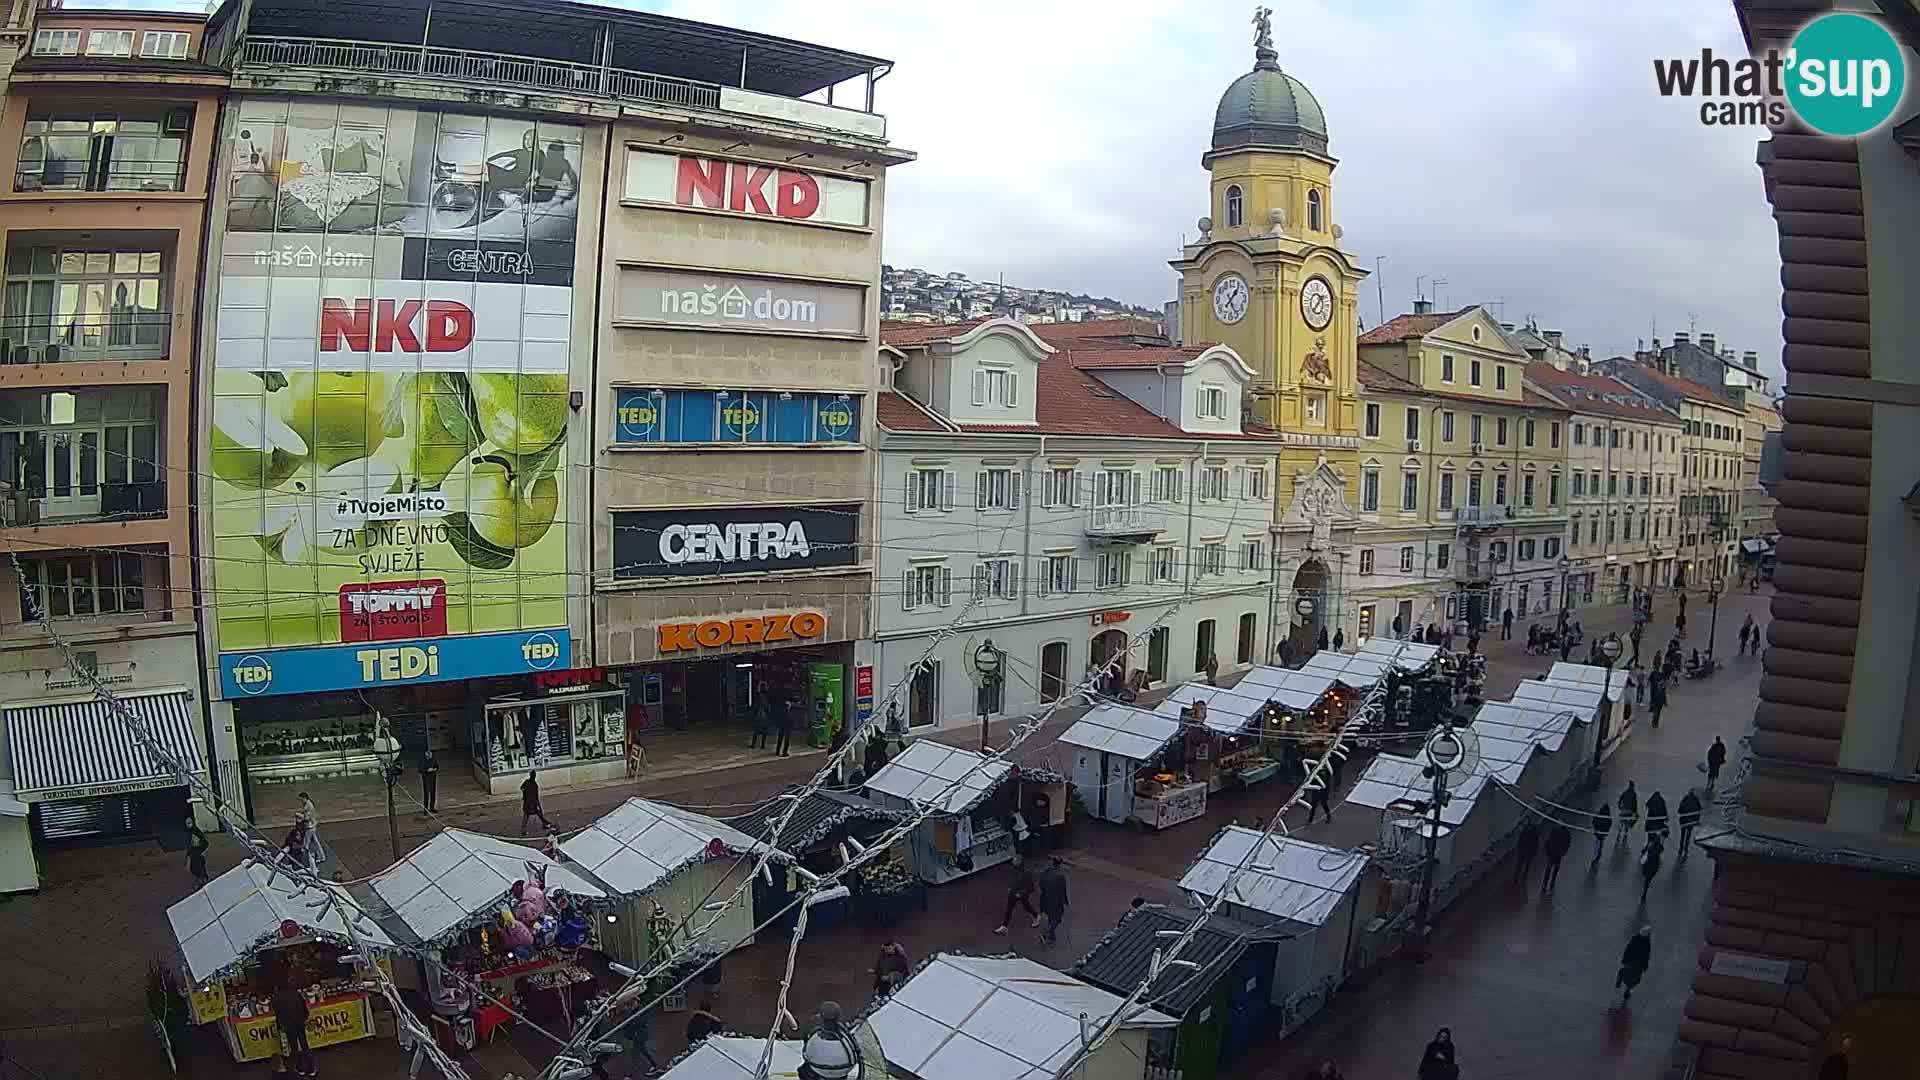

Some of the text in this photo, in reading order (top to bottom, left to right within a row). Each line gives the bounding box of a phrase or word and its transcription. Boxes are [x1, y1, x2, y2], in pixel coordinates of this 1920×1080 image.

[676, 156, 821, 220] NKD
[254, 243, 366, 269] naš dom
[447, 248, 535, 276] CENTRA
[660, 283, 817, 323] naš dom
[320, 297, 476, 354] NKD
[618, 407, 657, 425] TEDi
[723, 408, 760, 426] TEDi
[819, 410, 853, 427] TEDi
[337, 497, 445, 516] #TvojeMisto
[332, 524, 450, 549] ZA DNEVNO
[658, 520, 810, 564] CENTRA
[358, 547, 425, 575] SVJEŽE
[348, 586, 437, 615] TOMMY
[658, 612, 825, 652] KORZO
[357, 645, 439, 682] TEDi
[521, 642, 559, 660] TEDi
[233, 665, 272, 683] TEDi
